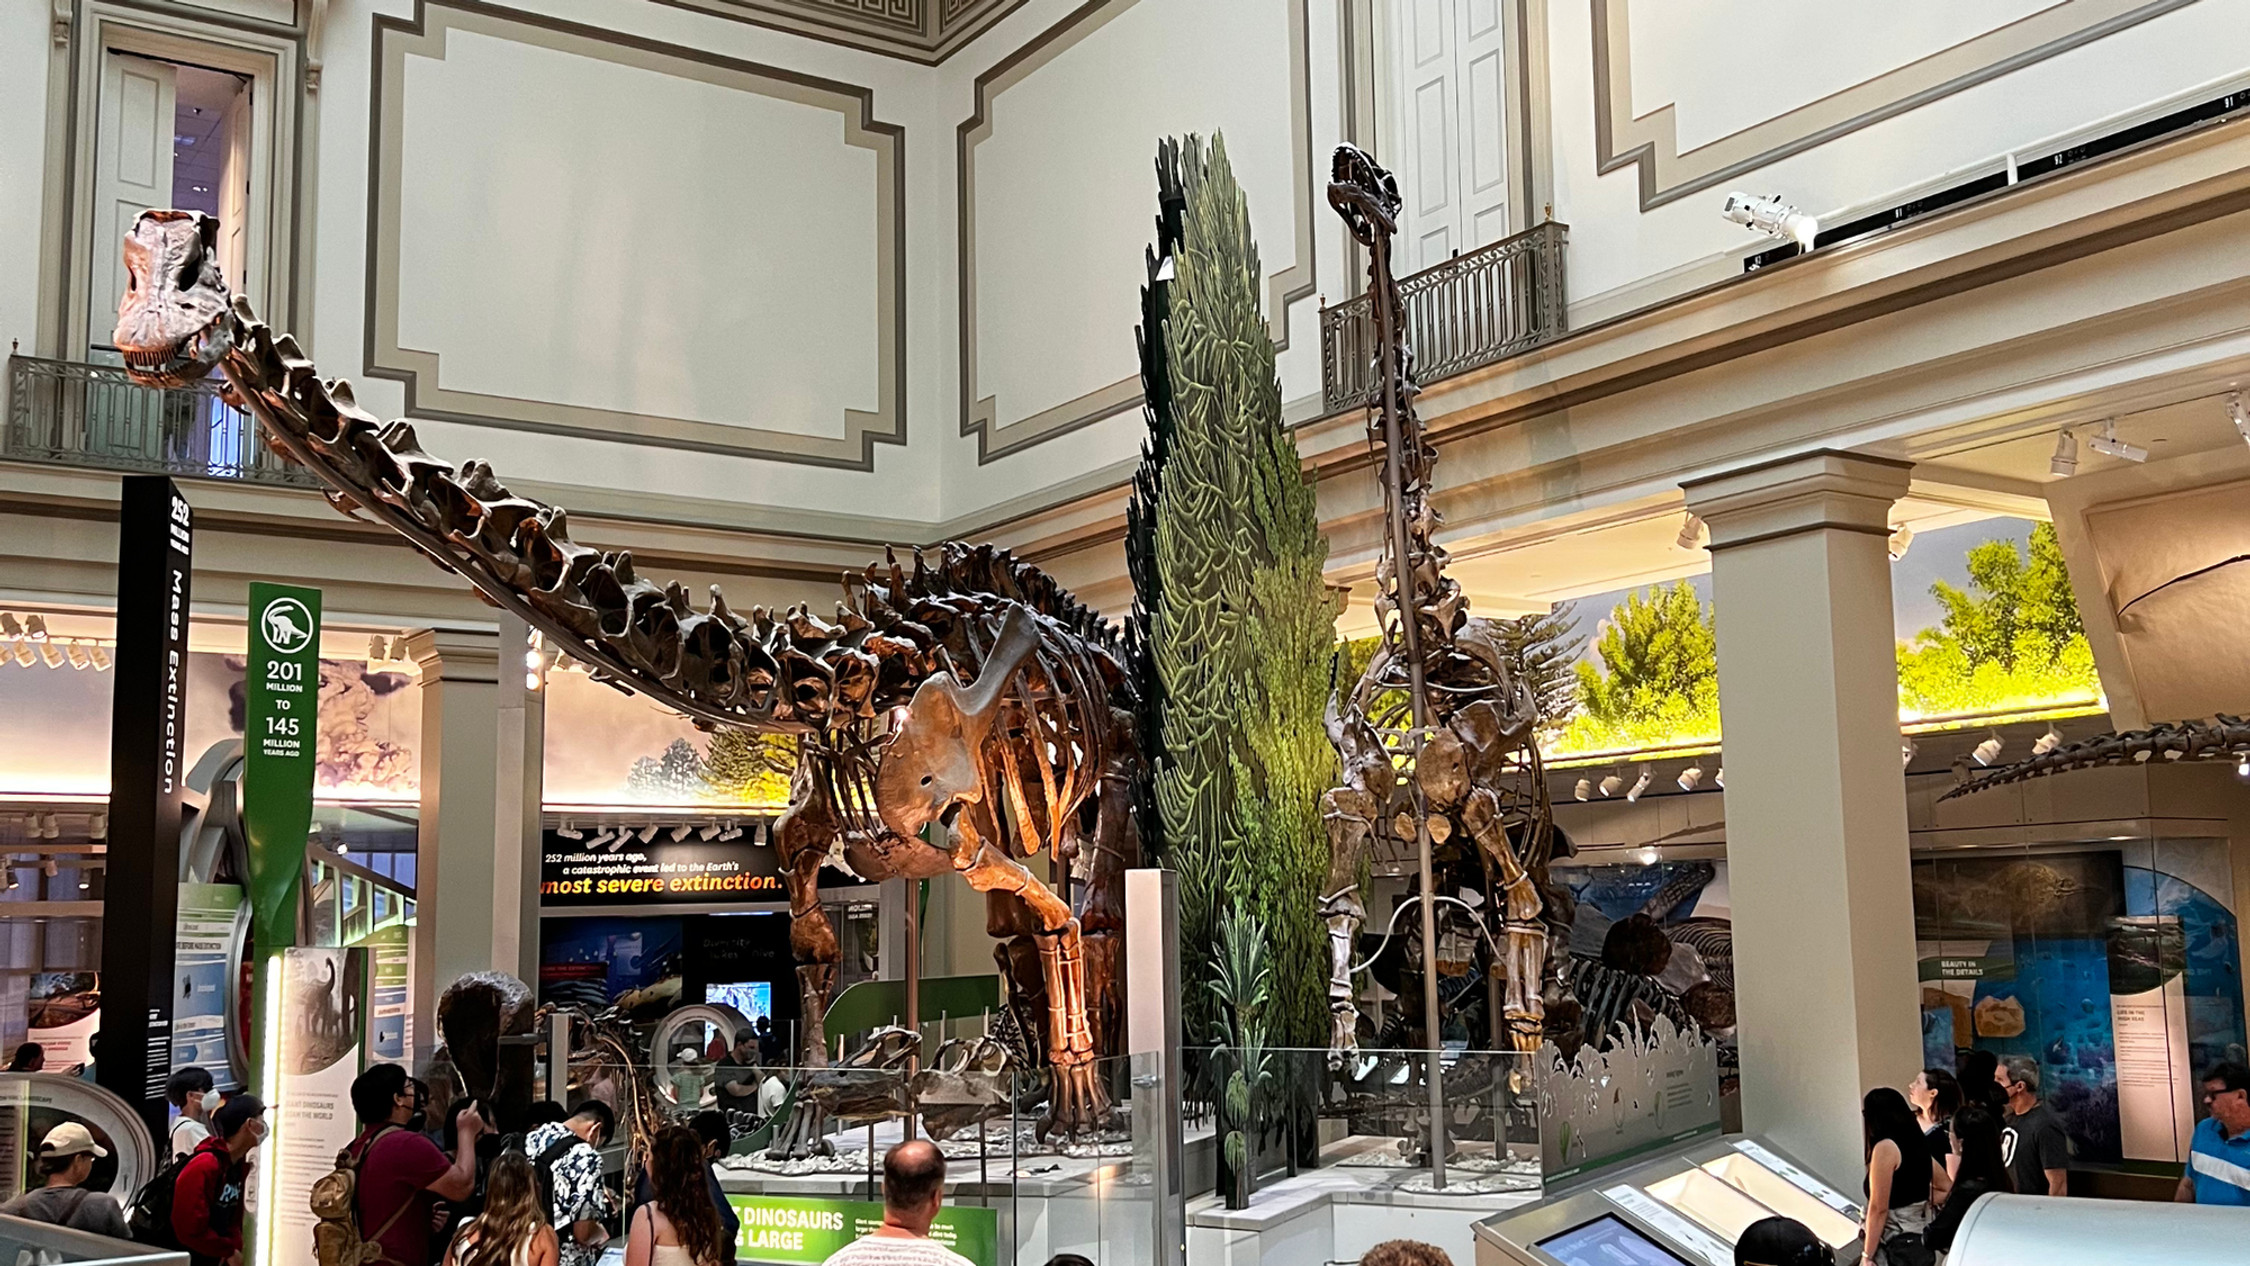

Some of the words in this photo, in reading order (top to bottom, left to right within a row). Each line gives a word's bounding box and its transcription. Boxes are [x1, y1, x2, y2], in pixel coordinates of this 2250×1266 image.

[171, 496, 190, 527] 252
[169, 570, 183, 642] Mass
[267, 660, 302, 681] 201
[266, 682, 303, 693] MILLION
[275, 699, 291, 710] TO
[164, 650, 179, 794] Extinction
[266, 716, 299, 736] 145
[263, 738, 300, 748] MILLION
[545, 854, 562, 863] 252
[564, 853, 596, 863] million
[597, 853, 625, 864] years
[625, 853, 647, 863] ago,
[563, 867, 570, 875] a
[571, 864, 631, 876] catastrophic
[632, 865, 659, 874] event
[660, 862, 676, 872] led
[677, 863, 688, 872] to
[689, 862, 705, 872] the
[706, 861, 739, 872] Earth's
[540, 877, 593, 894] most
[596, 878, 665, 894] severe
[669, 871, 783, 892] extinction.
[303, 1102, 334, 1110] DINOSAURS
[743, 1206, 844, 1231] DINOSAURS
[748, 1229, 804, 1251] LARGE
